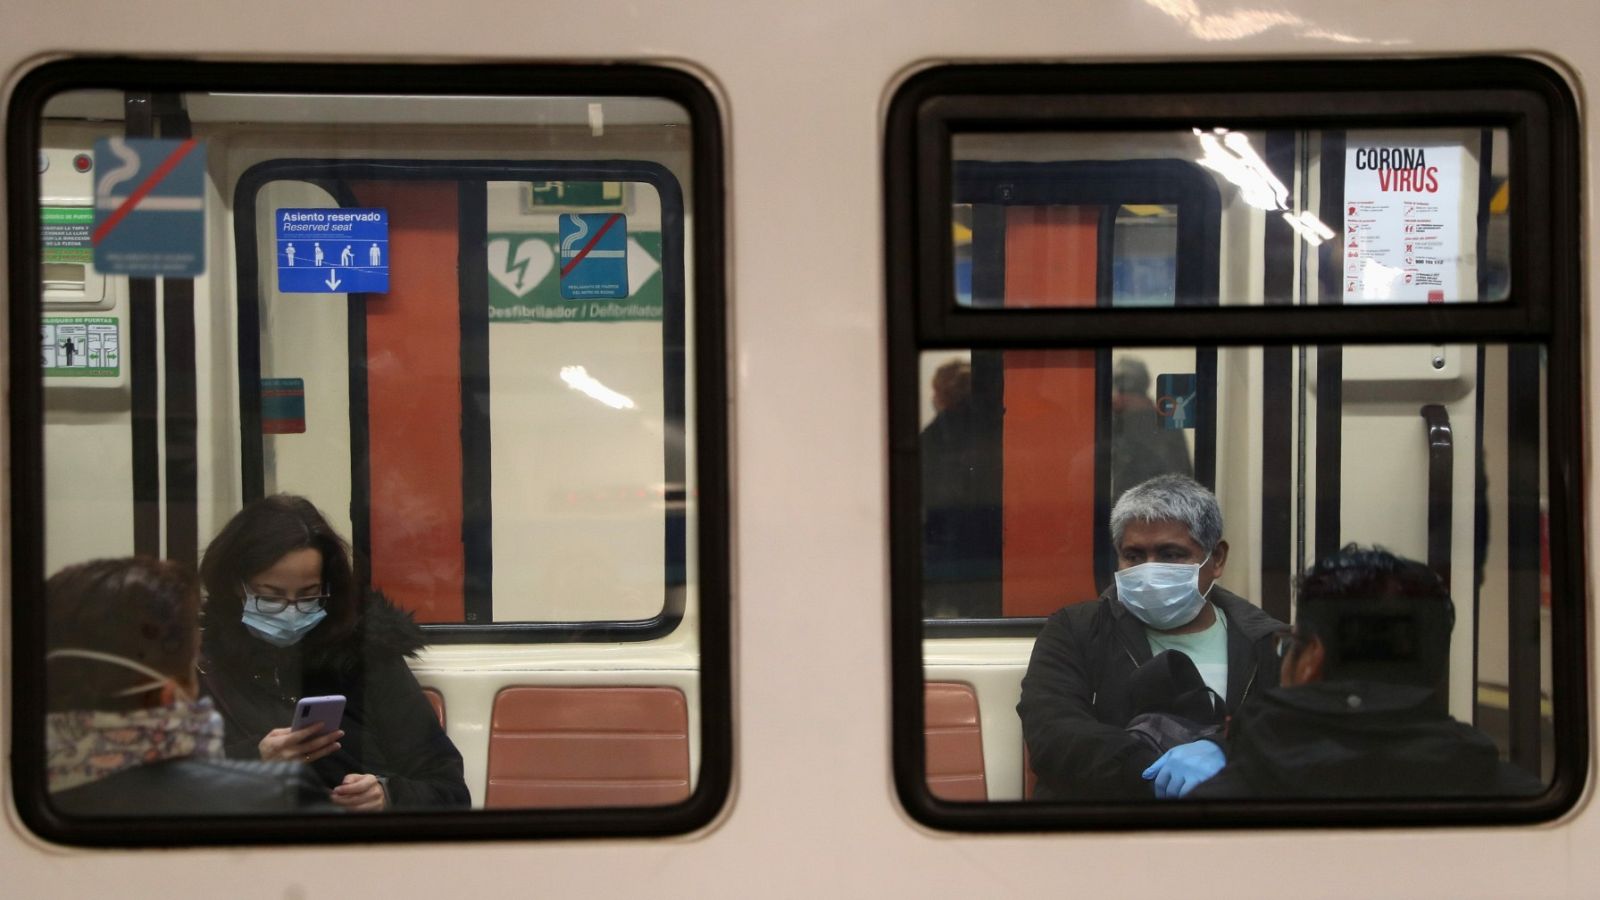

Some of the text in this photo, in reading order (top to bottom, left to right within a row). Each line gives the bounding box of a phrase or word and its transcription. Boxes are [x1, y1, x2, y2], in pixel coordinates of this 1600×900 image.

[1356, 148, 1426, 171] CORONA
[1378, 166, 1439, 193] VIRUS
[283, 212, 381, 222] Asiento reservado
[283, 222, 353, 231] Reserved seat
